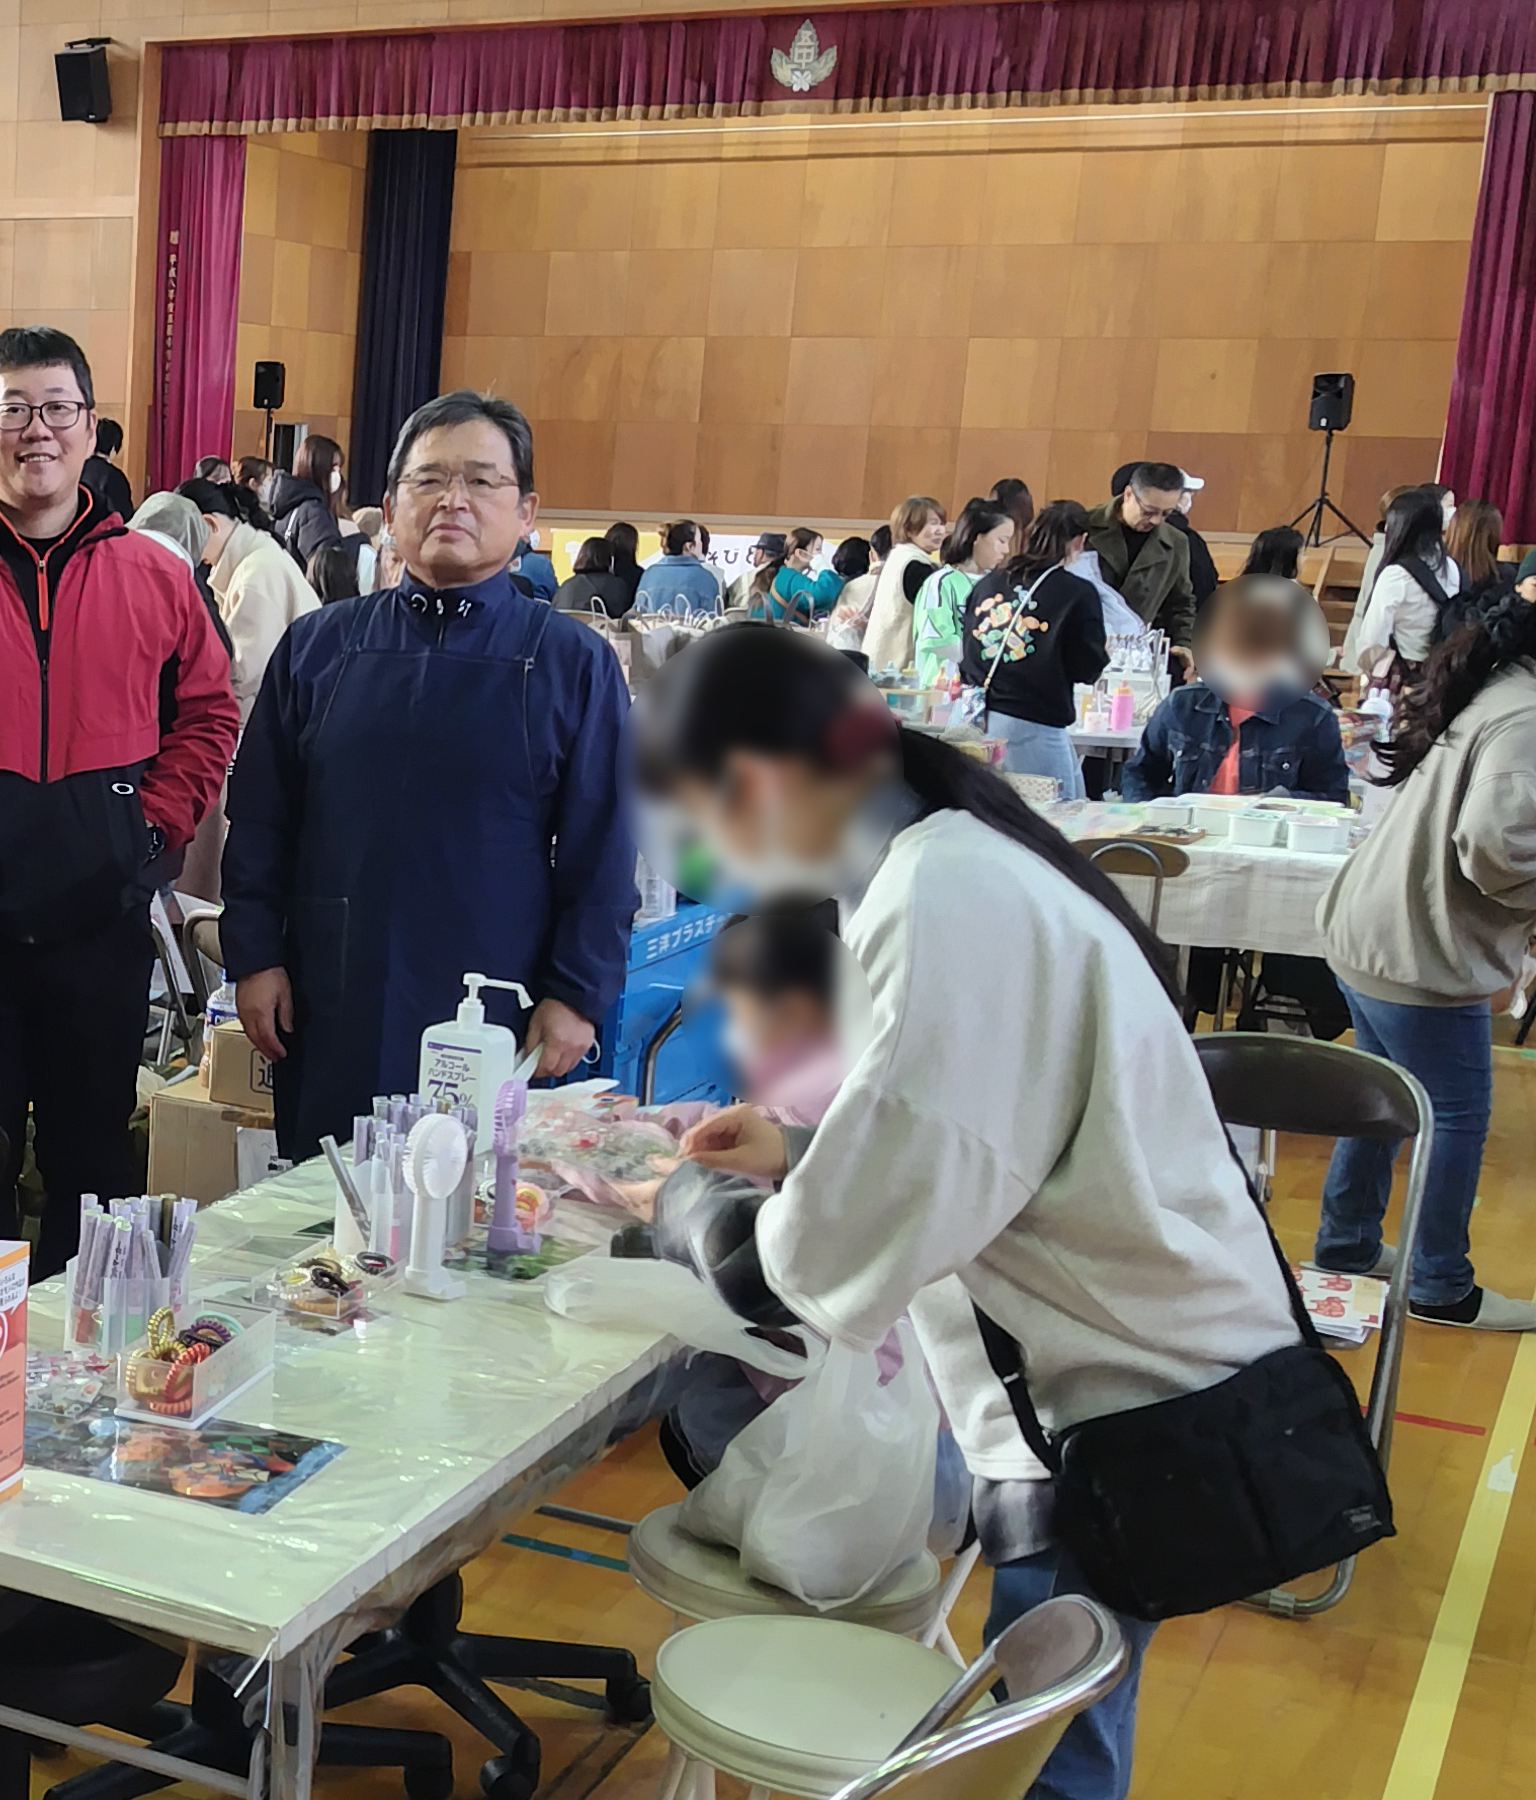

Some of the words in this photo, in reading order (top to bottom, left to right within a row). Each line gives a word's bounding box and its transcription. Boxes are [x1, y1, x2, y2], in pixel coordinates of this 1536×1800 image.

[434, 1058, 470, 1072] アルコール
[428, 1067, 477, 1083] ハンドスプレー
